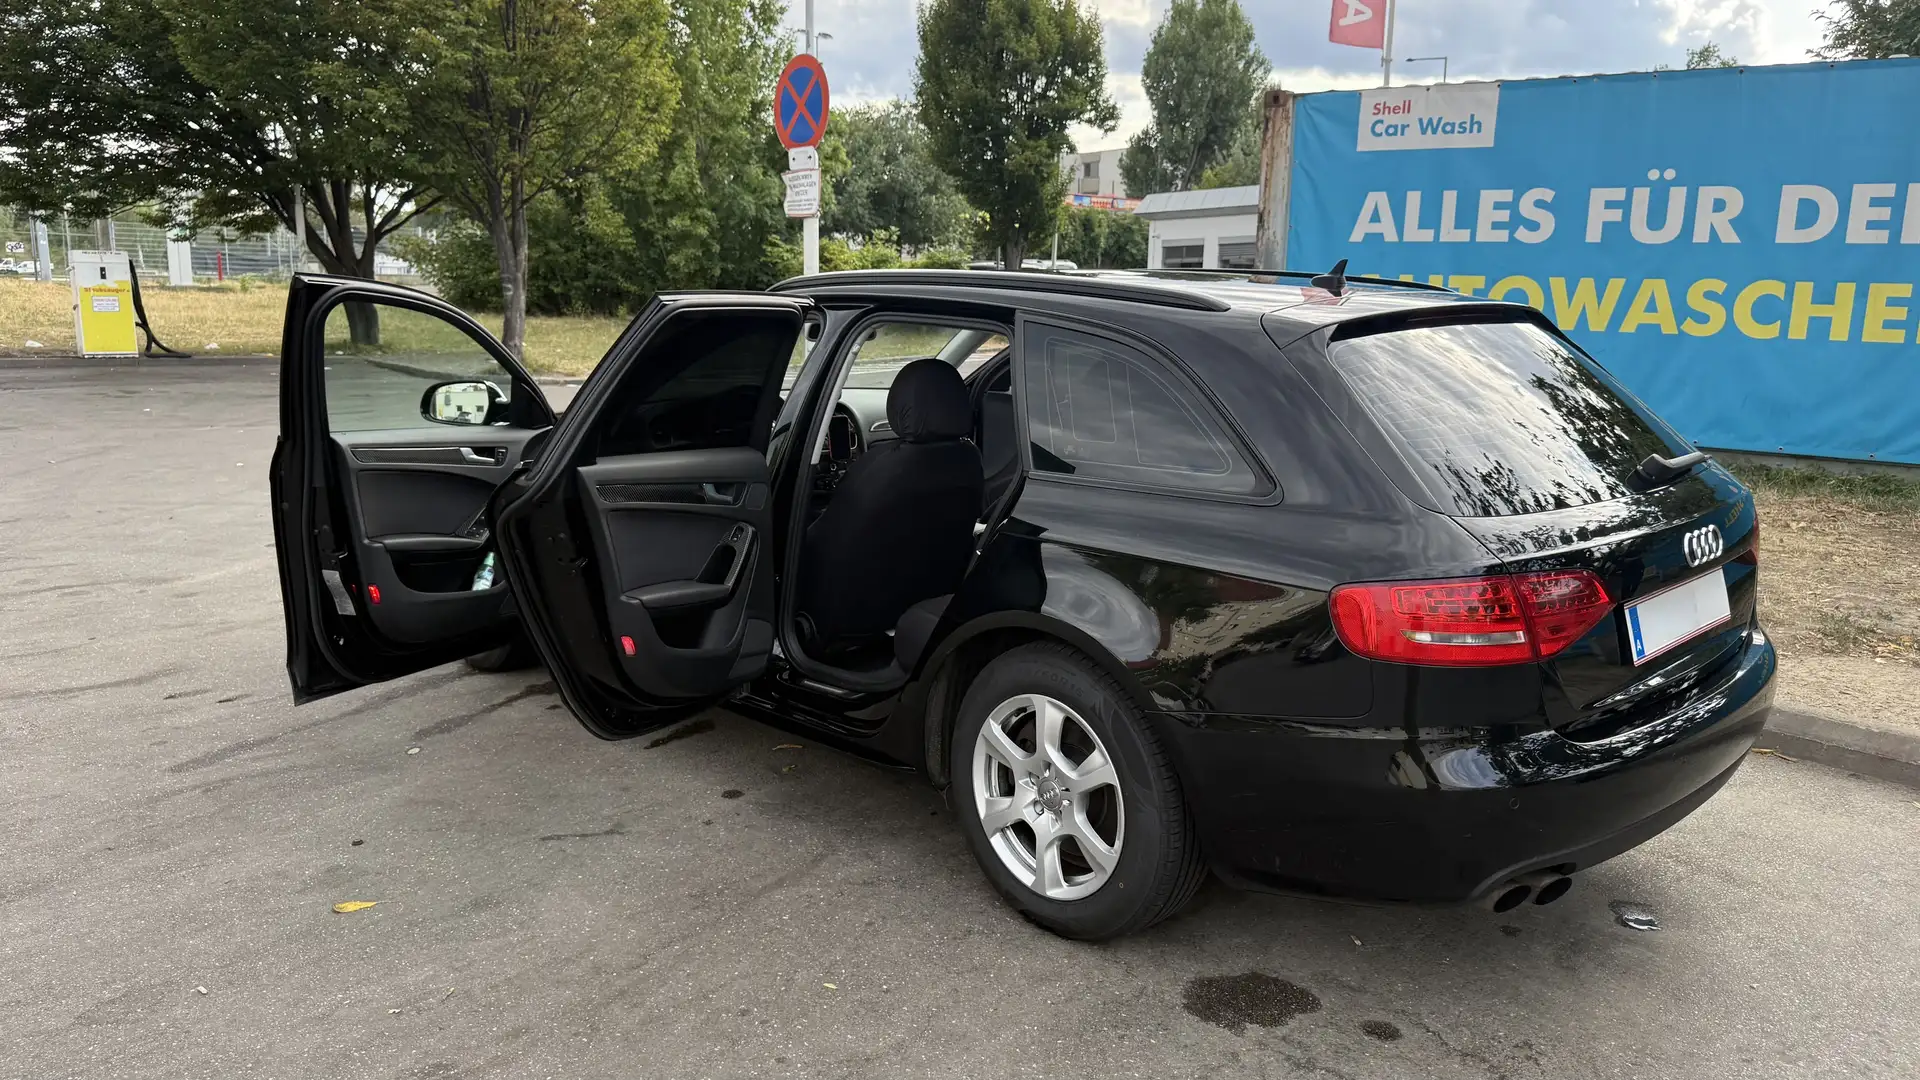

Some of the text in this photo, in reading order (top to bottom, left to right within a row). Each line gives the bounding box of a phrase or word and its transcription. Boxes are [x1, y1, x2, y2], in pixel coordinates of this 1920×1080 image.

[1372, 99, 1411, 116] Shell
[1370, 114, 1482, 137] Car Wash
[1348, 187, 1556, 244] ALLES
[1585, 169, 1745, 244] FÜR
[1636, 640, 1643, 651] A
